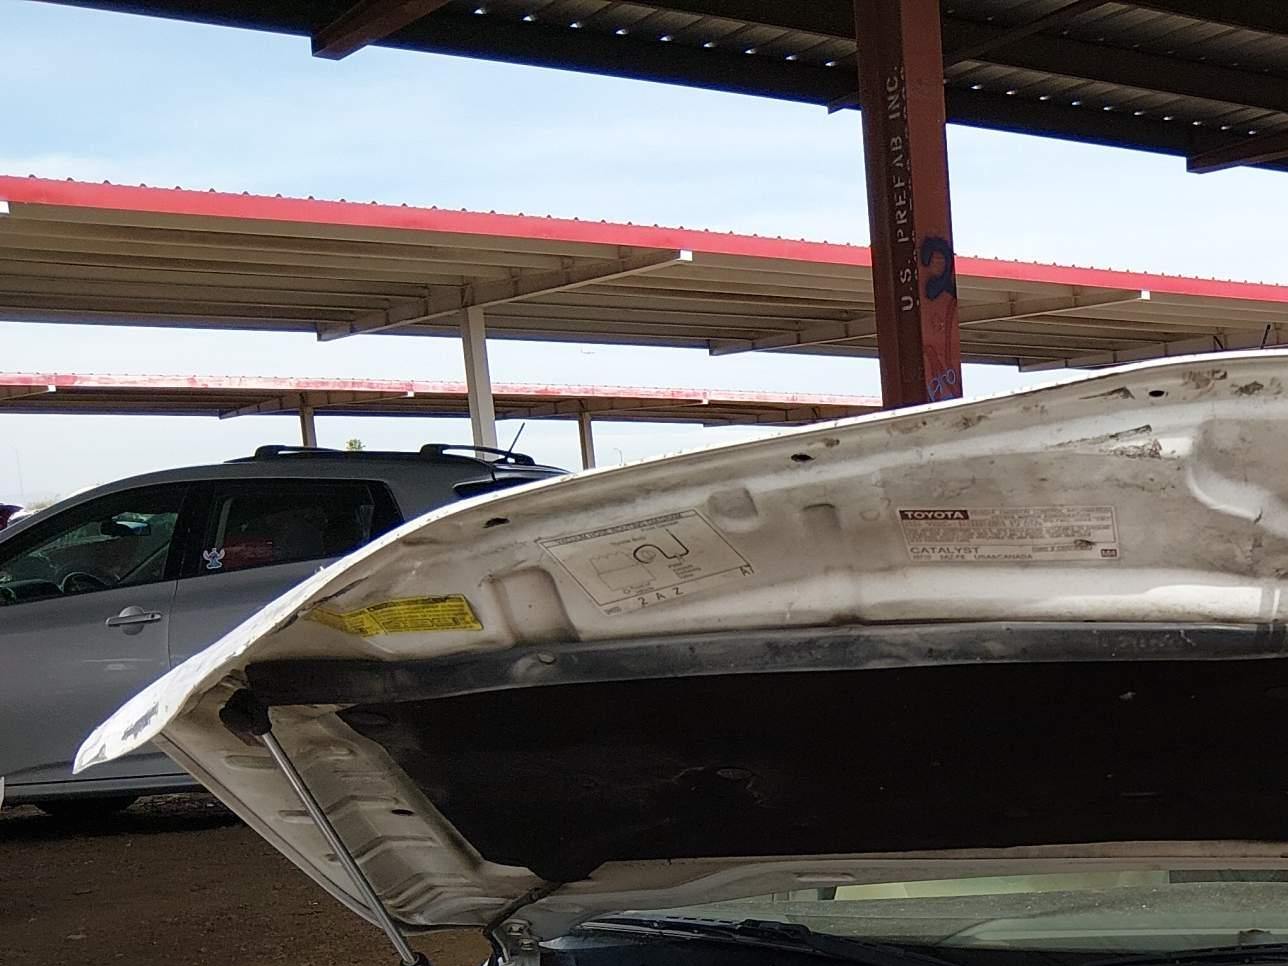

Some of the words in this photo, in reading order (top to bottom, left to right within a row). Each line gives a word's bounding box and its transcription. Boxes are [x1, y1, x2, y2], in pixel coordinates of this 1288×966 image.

[885, 65, 900, 120] INC.
[889, 135, 911, 244] PREFAB
[900, 257, 915, 312] U.S.
[904, 511, 963, 520] TOYOTA
[910, 546, 980, 555] CATALYST
